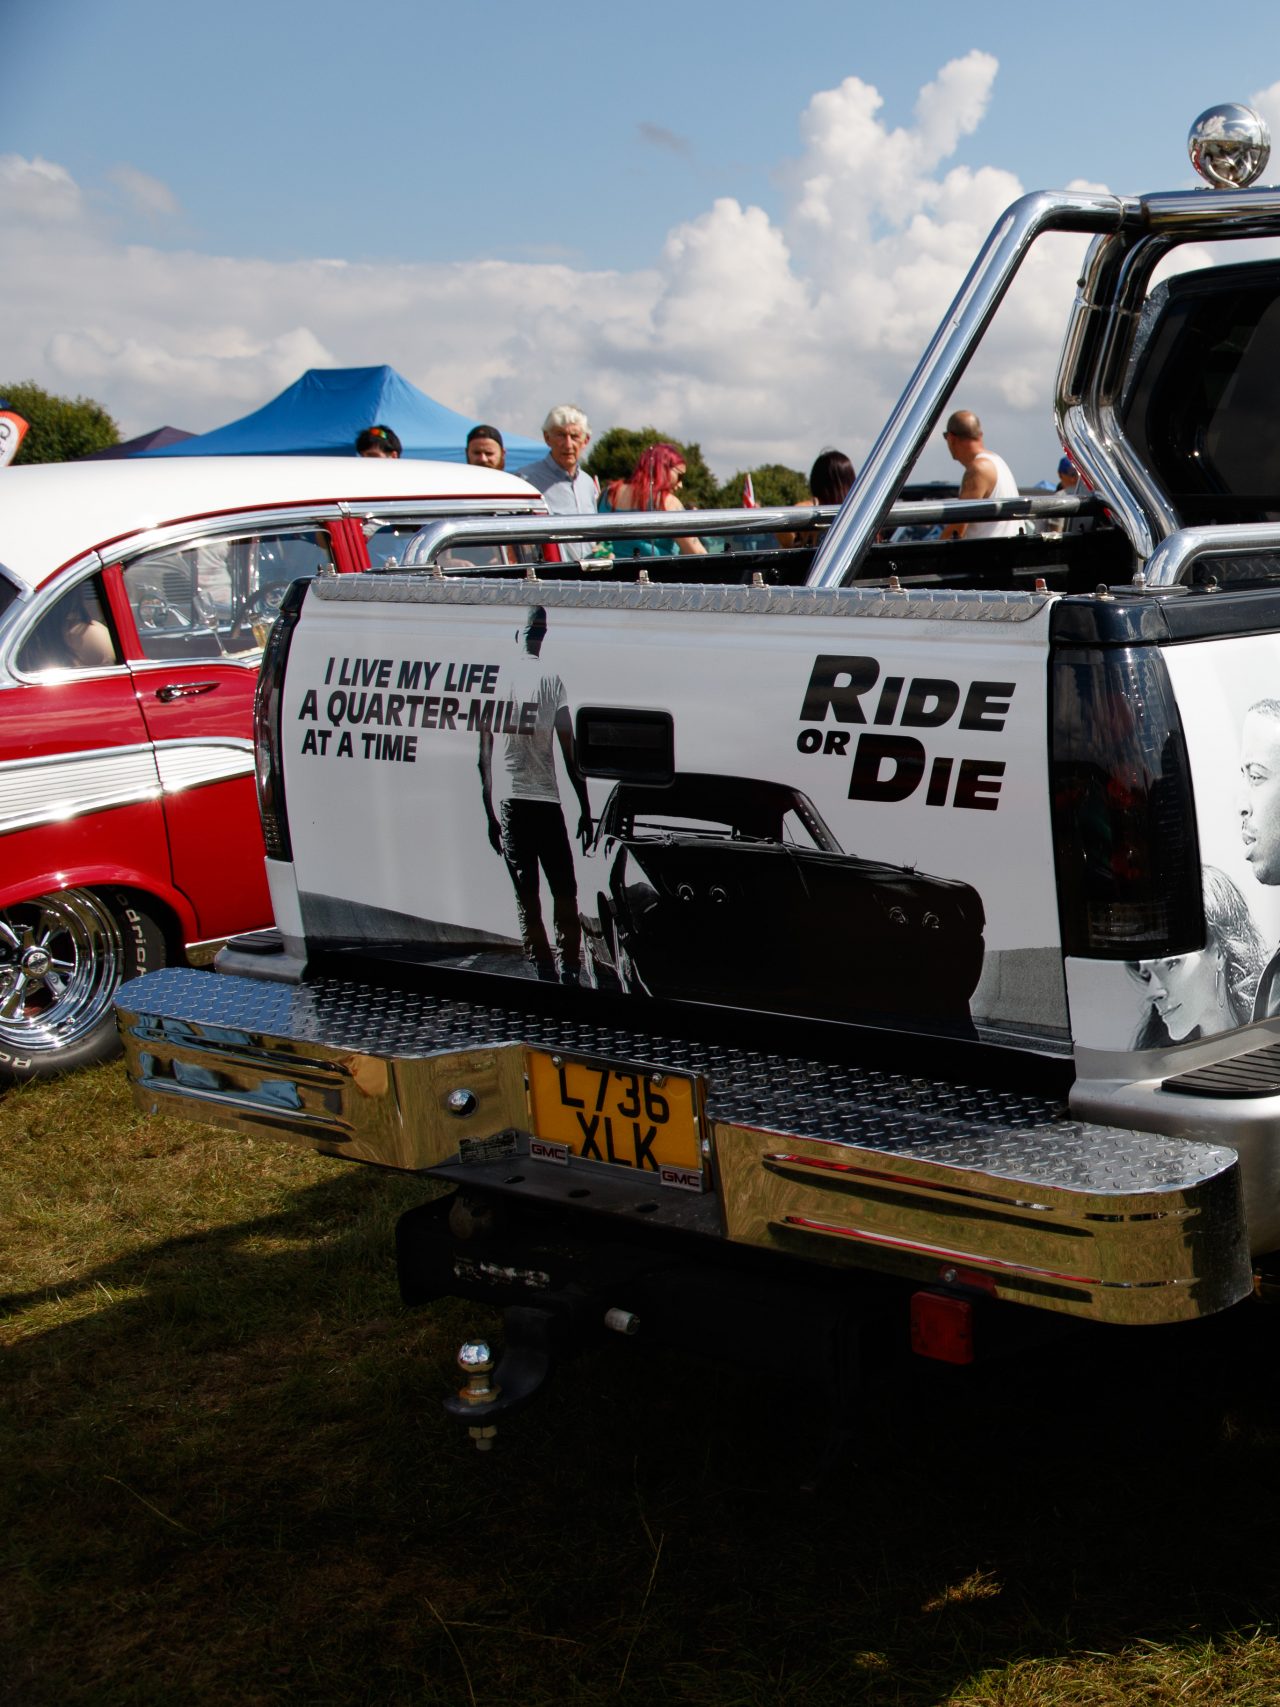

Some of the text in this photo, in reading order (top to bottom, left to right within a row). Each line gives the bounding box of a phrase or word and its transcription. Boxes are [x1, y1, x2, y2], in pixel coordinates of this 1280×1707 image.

[324, 656, 500, 694] I LIVE MY LIFE
[799, 654, 1017, 732] RIDE
[298, 689, 539, 736] A QUARTER-MILE
[300, 728, 418, 763] AT A TIME
[796, 728, 1006, 811] OR DIE
[558, 1064, 670, 1124] L736
[530, 1143, 567, 1161] GMC
[575, 1110, 660, 1173] XLK
[661, 1169, 700, 1187] GMC
